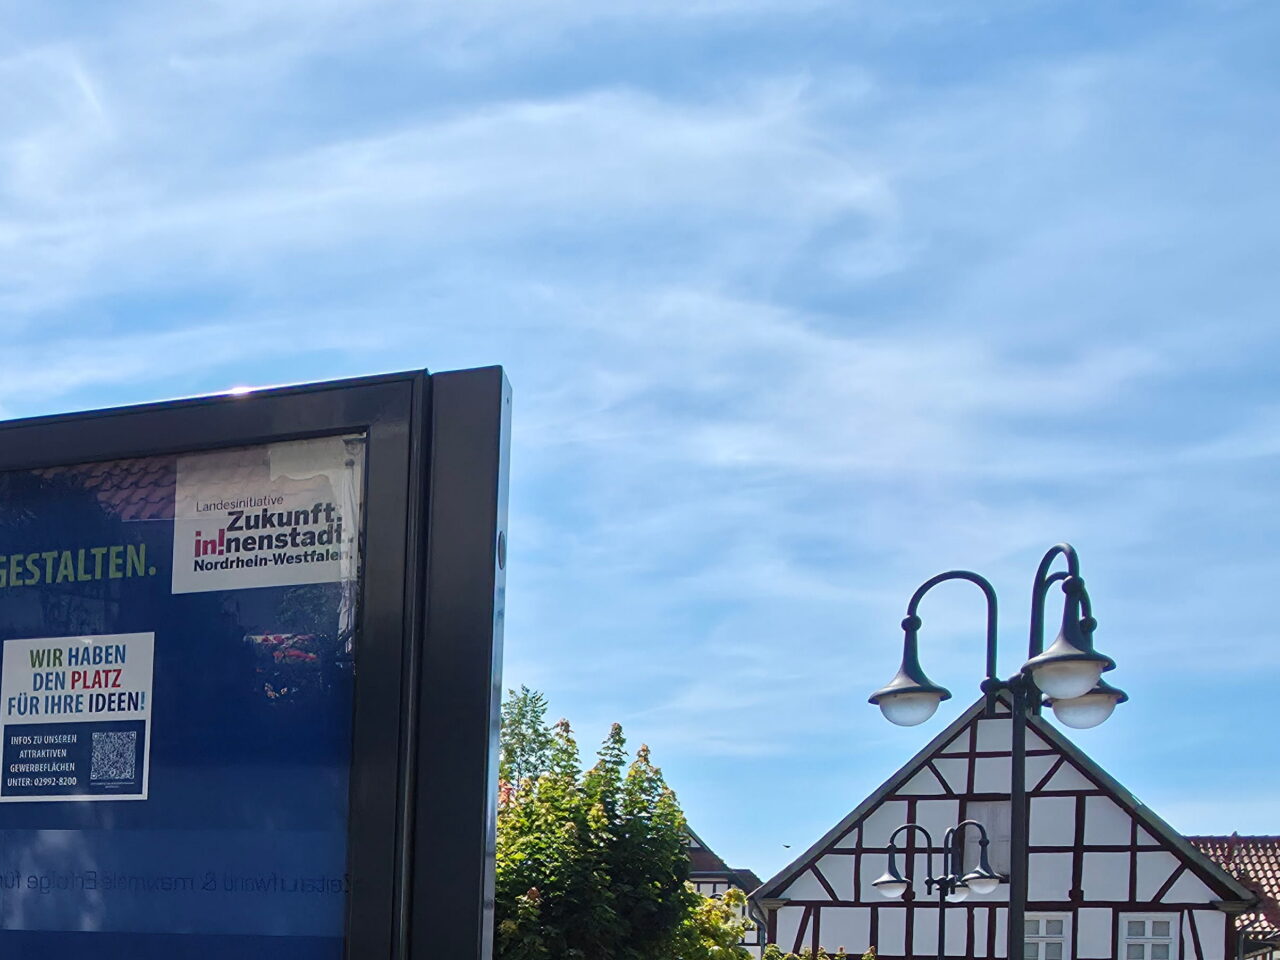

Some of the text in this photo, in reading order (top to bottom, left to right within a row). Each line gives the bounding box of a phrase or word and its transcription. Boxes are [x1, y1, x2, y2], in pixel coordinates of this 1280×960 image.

[195, 495, 284, 513] Landesinitiative
[193, 549, 353, 572] Nordrhein-Westfalen.
[30, 644, 126, 668] WIR HABEN
[33, 668, 122, 691] DEN PLATZ
[7, 691, 146, 716] FÜR IHRE IDEEN!
[10, 734, 77, 745] INFOS ZU UNSEREN
[19, 748, 67, 759] ATTRAKTIVEN
[9, 761, 76, 774] GEWERBEFLÄCHEN
[7, 776, 33, 787] UNTER:
[33, 776, 77, 787] 02992-8200
